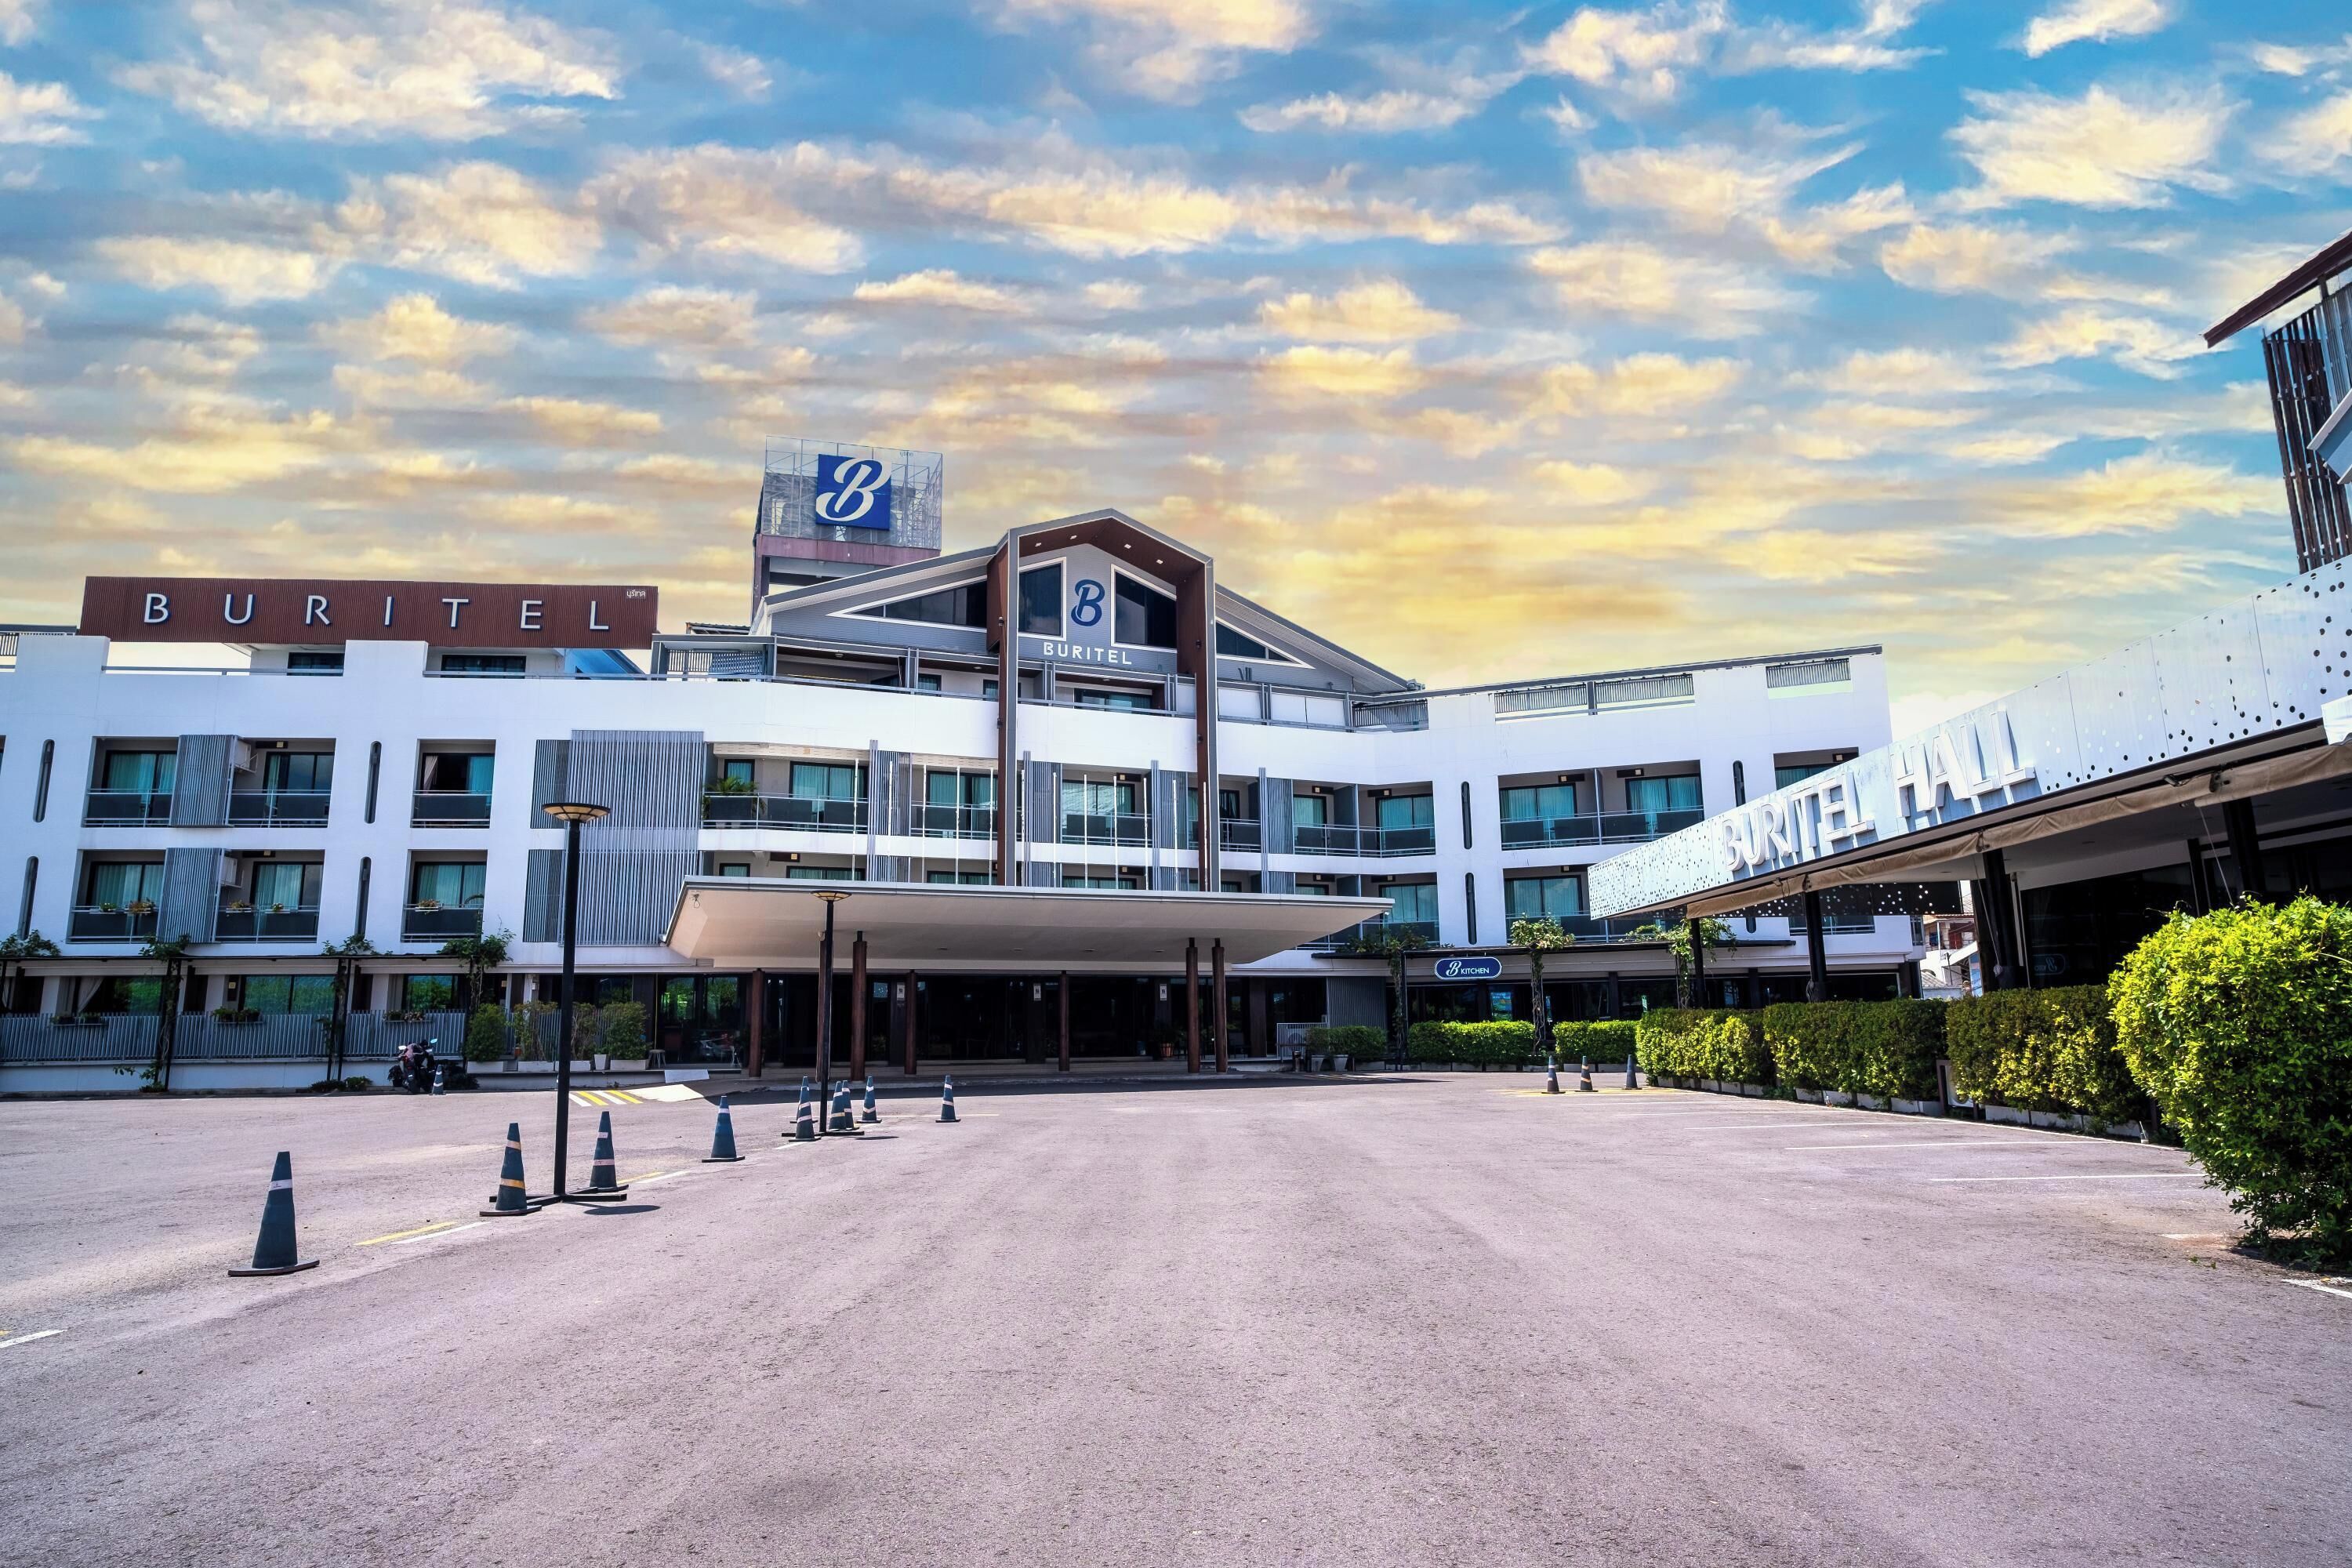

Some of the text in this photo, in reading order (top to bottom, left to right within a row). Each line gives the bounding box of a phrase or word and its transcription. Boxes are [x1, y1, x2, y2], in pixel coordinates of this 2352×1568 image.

[816, 458, 891, 521] B
[143, 593, 610, 630] BURITEL
[1071, 579, 1105, 626] B
[1044, 642, 1132, 665] BURITEL
[1722, 710, 2035, 872] BURITEL HALL
[1446, 960, 1461, 976] B
